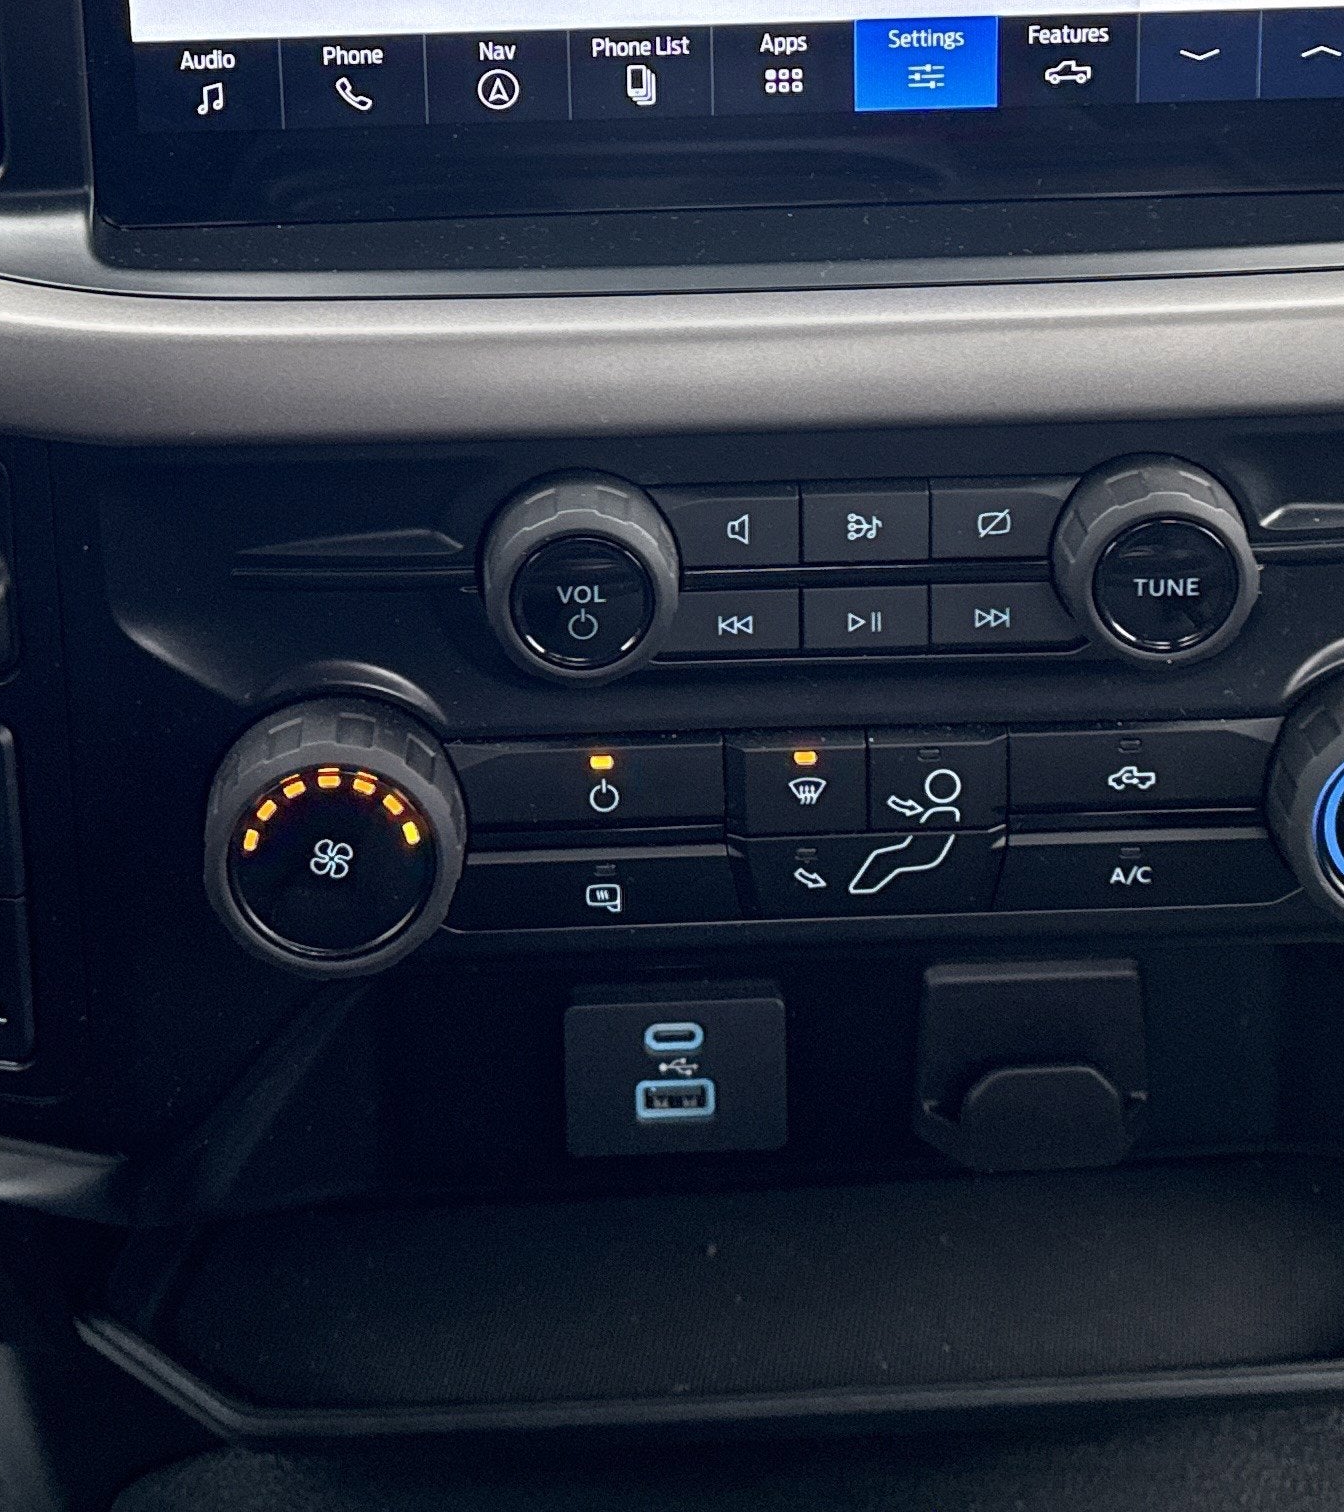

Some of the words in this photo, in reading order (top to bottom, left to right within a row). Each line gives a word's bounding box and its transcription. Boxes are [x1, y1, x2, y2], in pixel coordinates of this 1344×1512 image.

[760, 33, 807, 55] Apps
[889, 29, 964, 50] Settings
[1029, 25, 1109, 44] Features
[323, 46, 383, 65] Phone
[479, 42, 516, 60] Nav
[592, 38, 651, 57] Phone
[656, 36, 689, 55] List
[181, 50, 235, 69] Audio
[557, 585, 606, 603] VOL
[1134, 578, 1199, 596] TUNE
[1110, 866, 1151, 884] A/C
